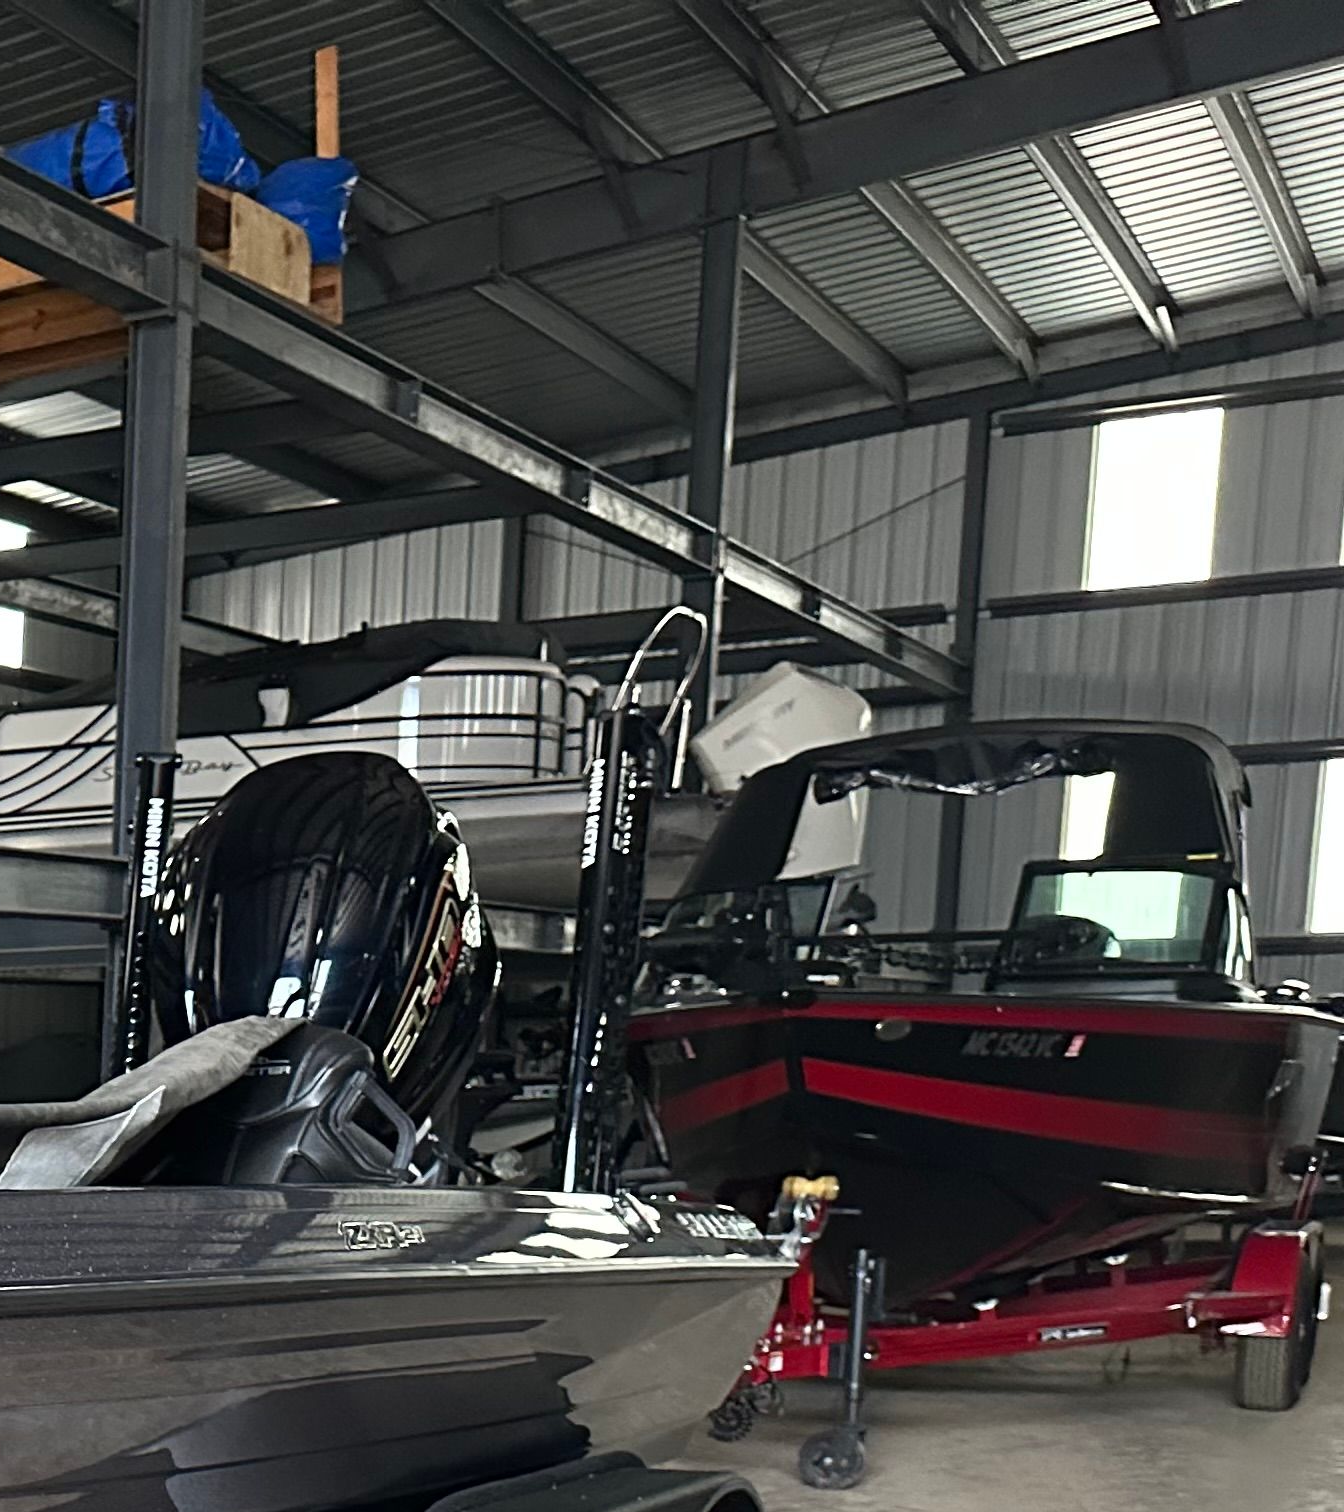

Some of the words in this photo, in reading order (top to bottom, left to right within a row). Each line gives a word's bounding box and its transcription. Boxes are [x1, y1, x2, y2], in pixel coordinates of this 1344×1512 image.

[587, 758, 606, 813] MINN
[144, 797, 165, 848] MINN
[581, 814, 600, 869] KOTA
[140, 849, 161, 898] KOTA
